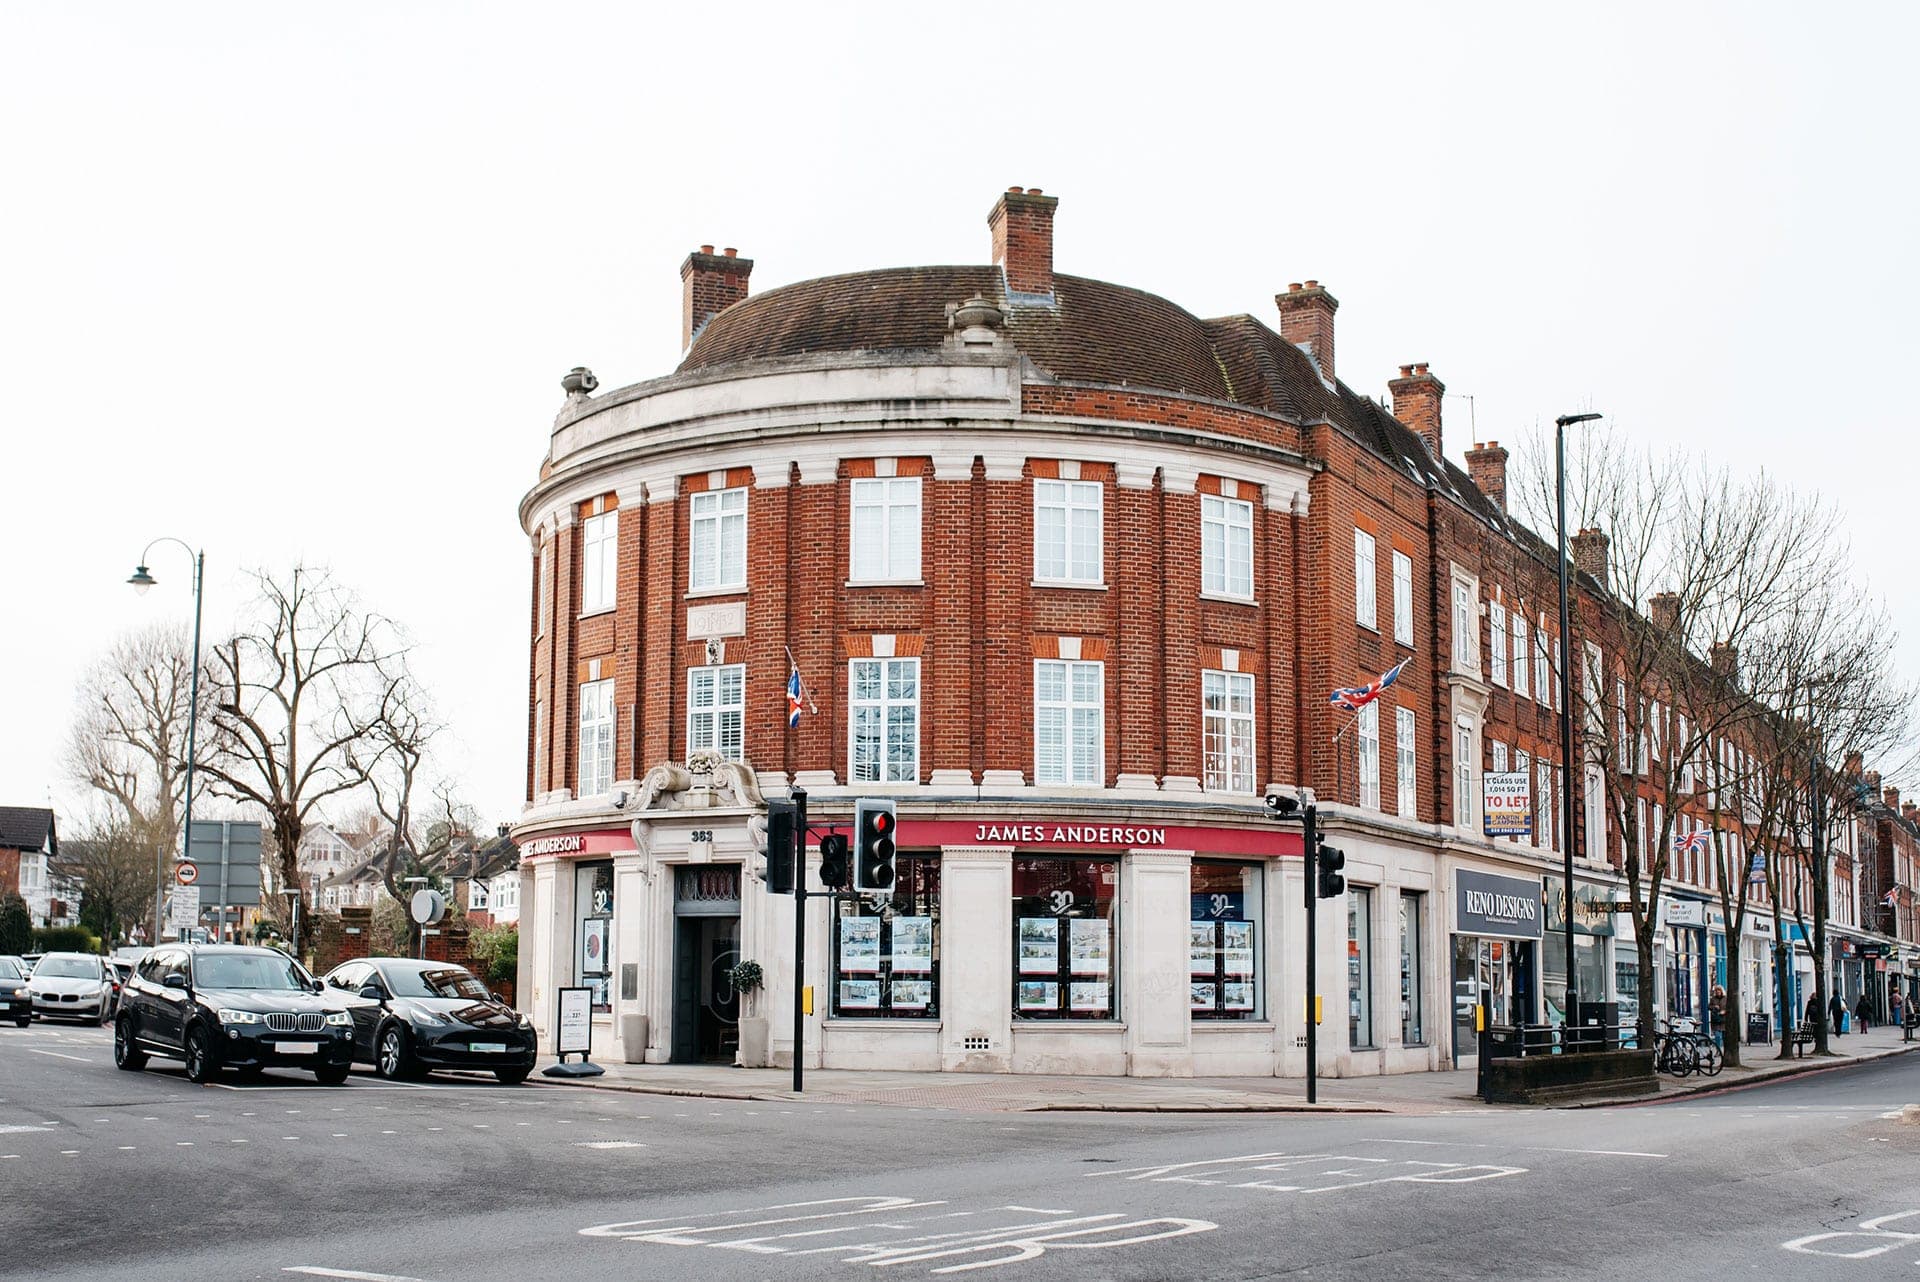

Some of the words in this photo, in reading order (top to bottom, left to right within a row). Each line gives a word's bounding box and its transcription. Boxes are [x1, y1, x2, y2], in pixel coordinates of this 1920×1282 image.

[1486, 796, 1502, 807] TO
[1506, 796, 1528, 808] LET
[534, 836, 580, 855] ANDERSON
[975, 825, 1045, 842] JAMES
[1052, 827, 1165, 845] ANDERSON
[1049, 890, 1074, 914] 30
[1210, 894, 1229, 917] 30
[1466, 890, 1494, 915] RENO
[1495, 894, 1535, 920] DESIGNS
[1084, 1152, 1528, 1193] KEEP
[578, 1196, 1219, 1273] CLEAR
